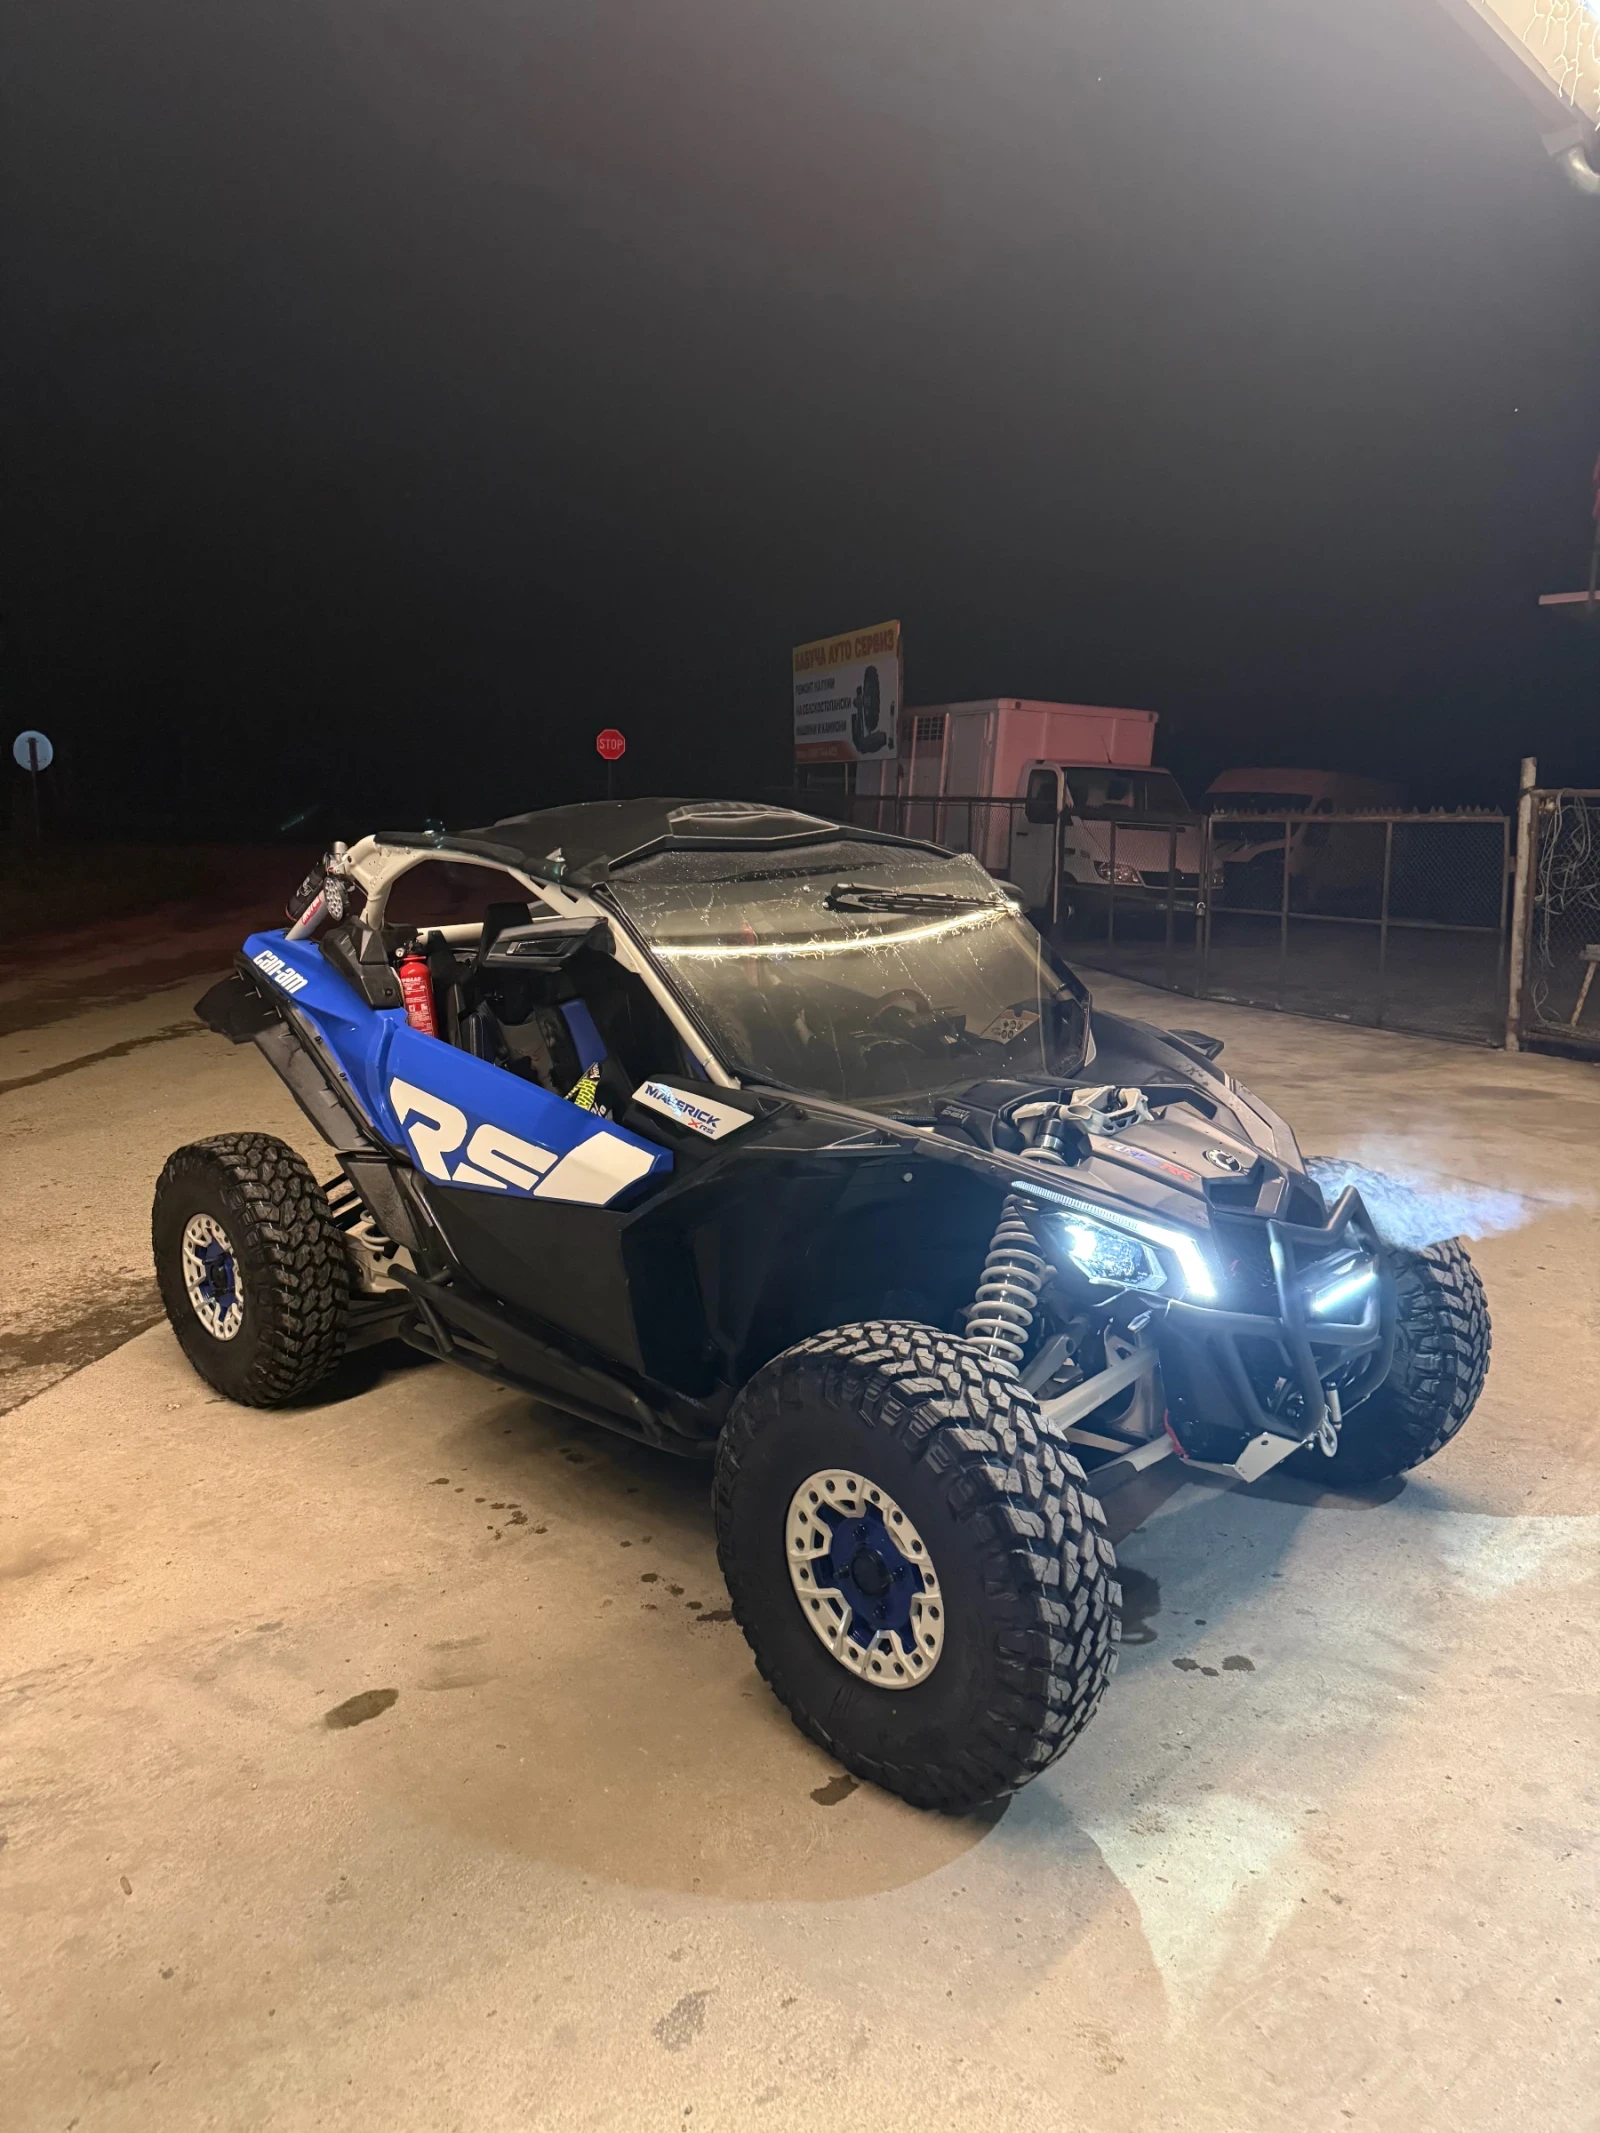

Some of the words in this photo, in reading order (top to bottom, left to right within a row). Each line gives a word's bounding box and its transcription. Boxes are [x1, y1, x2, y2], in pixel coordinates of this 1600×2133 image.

[828, 640, 852, 665] АУТО
[855, 628, 894, 658] СЕРВИЗ
[599, 738, 623, 750] STOP
[252, 949, 309, 994] can-am
[388, 1077, 559, 1191] RS
